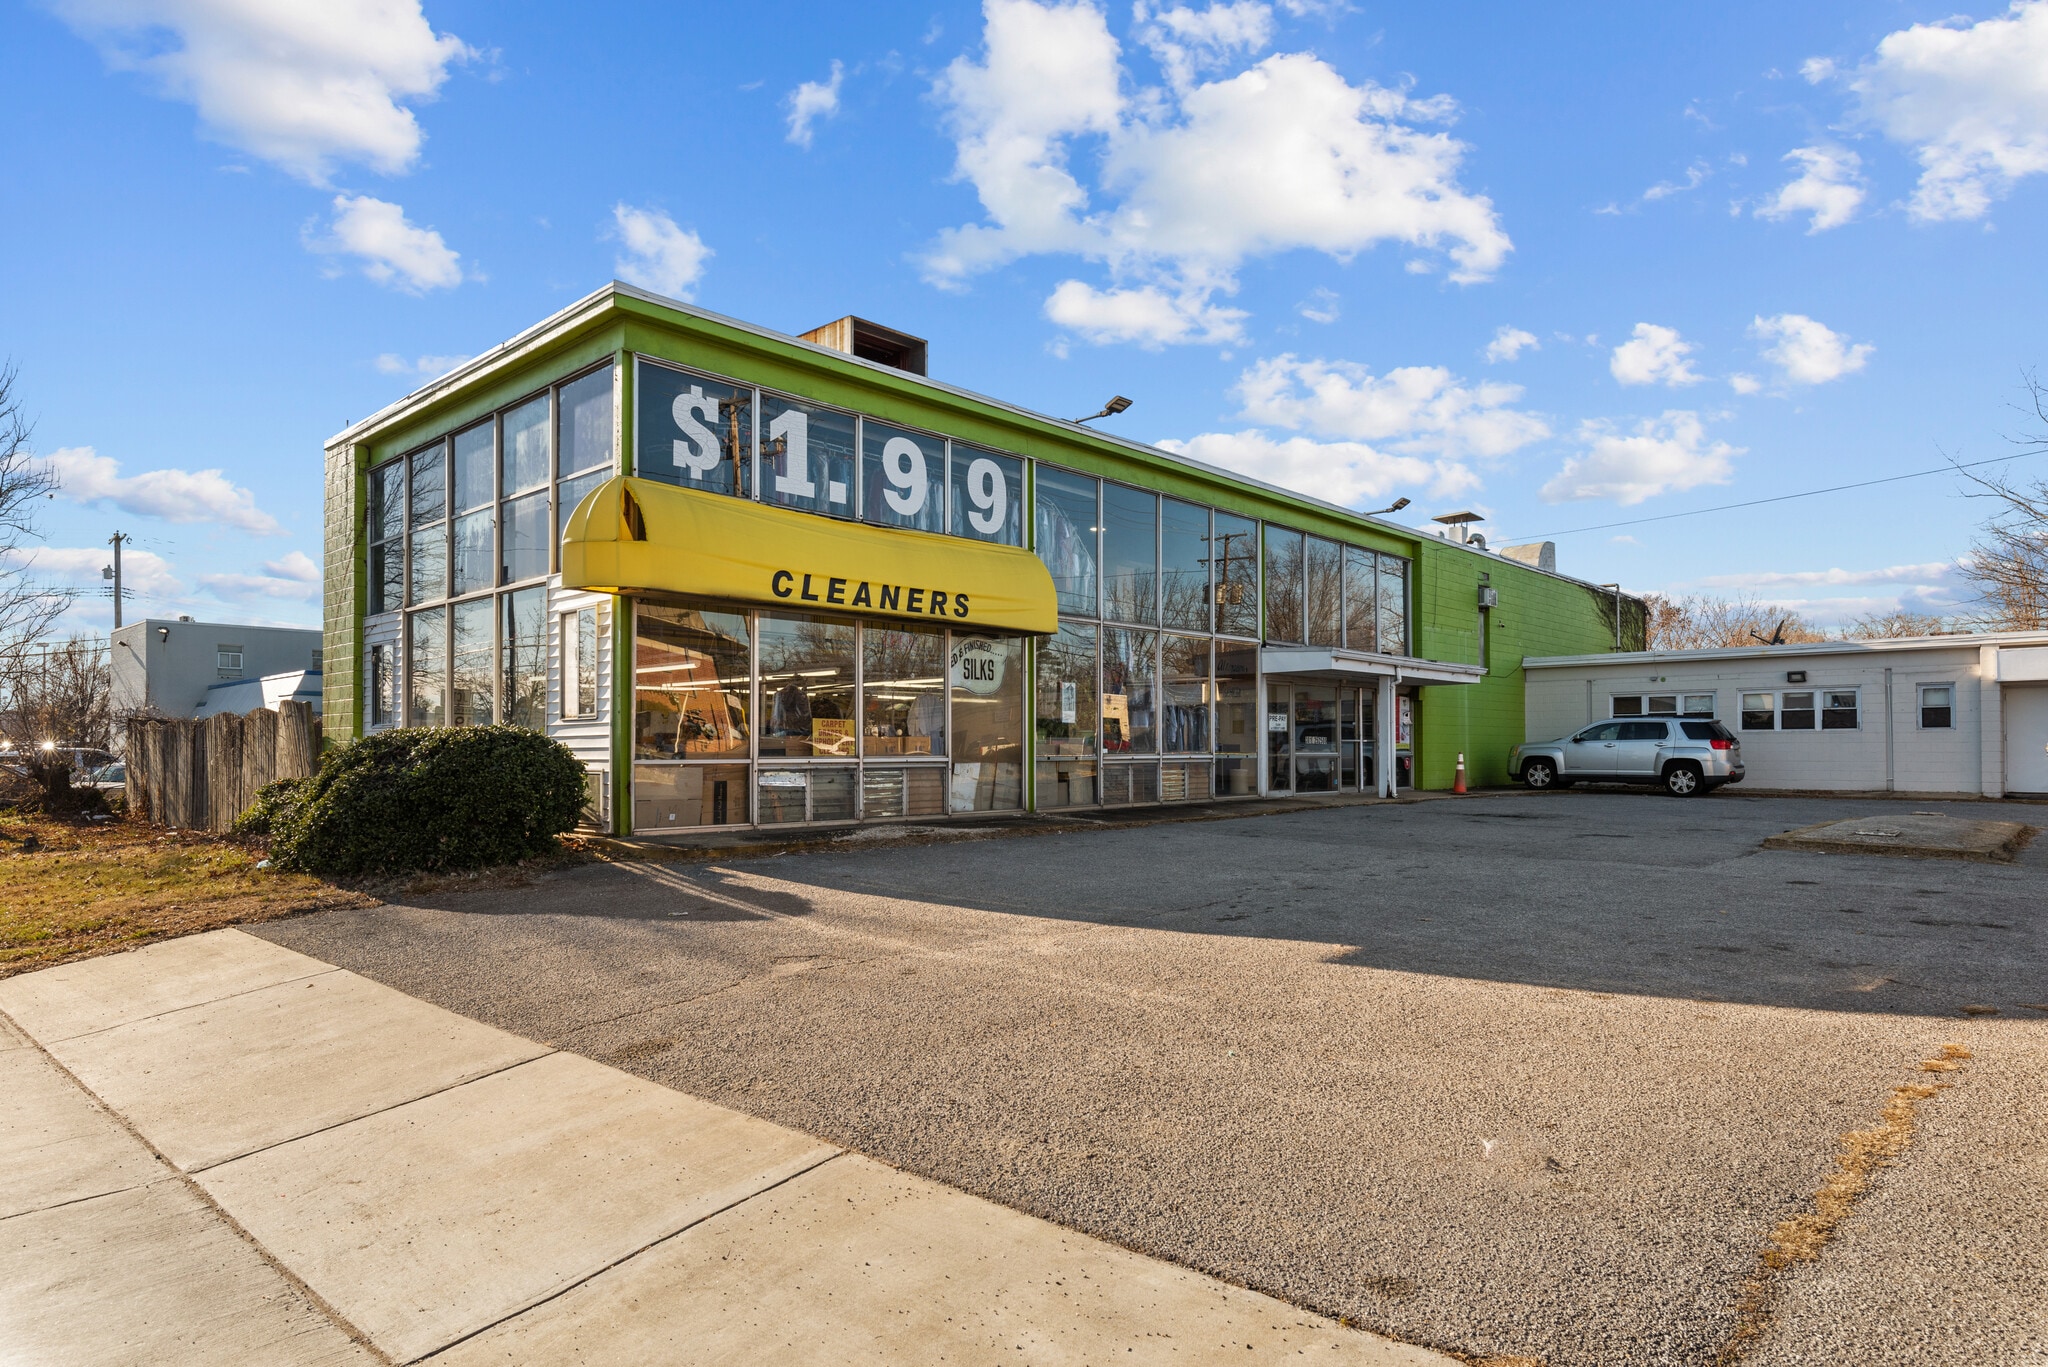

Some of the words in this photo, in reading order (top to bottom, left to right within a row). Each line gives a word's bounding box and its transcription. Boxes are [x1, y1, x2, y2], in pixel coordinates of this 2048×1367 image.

[772, 570, 970, 618] CLEANERS
[963, 658, 994, 681] SILKS
[821, 720, 846, 728] CARPET
